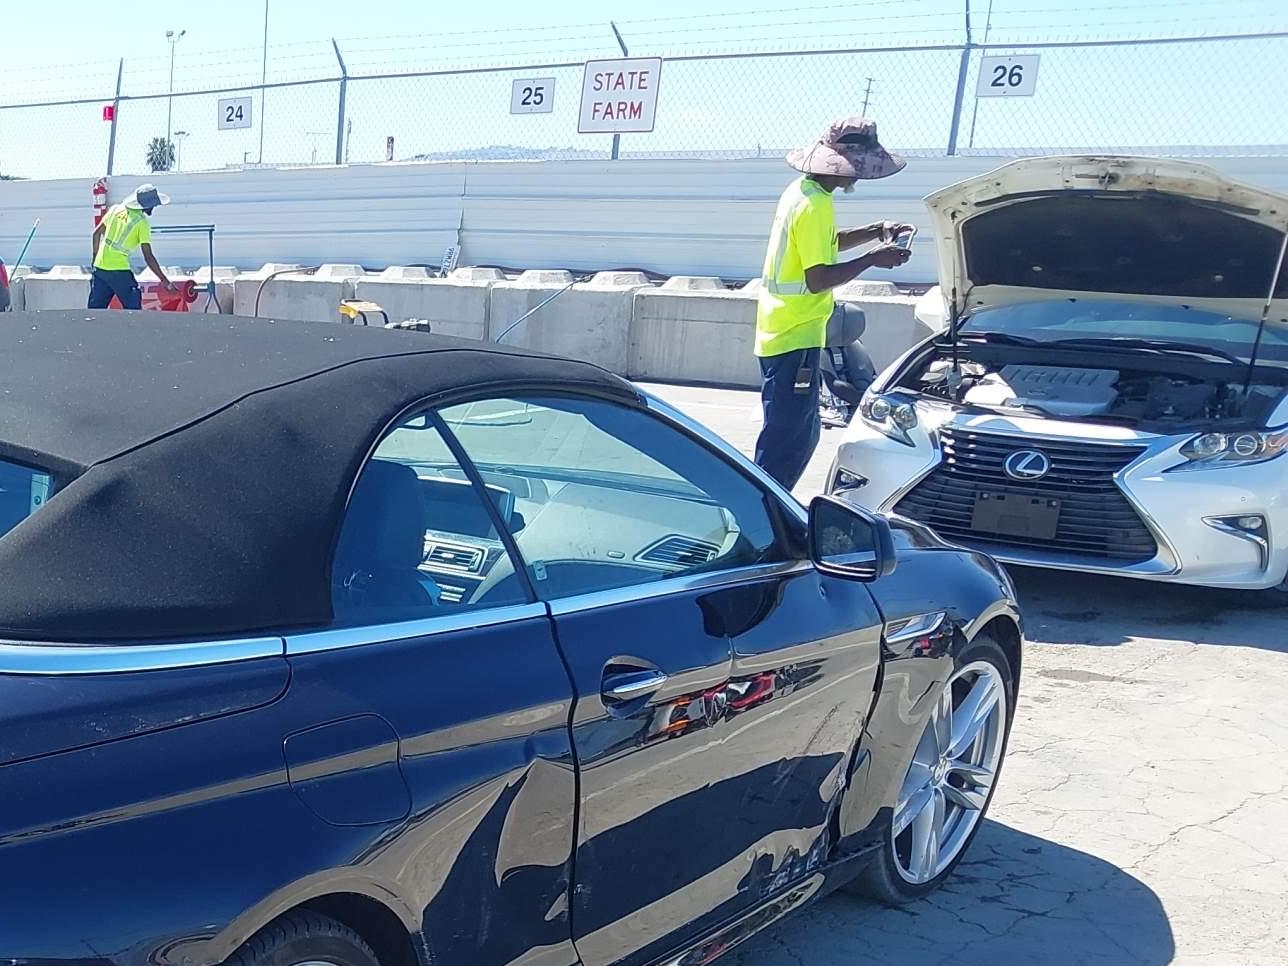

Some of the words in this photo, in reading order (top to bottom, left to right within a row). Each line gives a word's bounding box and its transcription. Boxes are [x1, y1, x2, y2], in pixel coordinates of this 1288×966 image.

[593, 71, 649, 91] STATE
[991, 64, 1024, 88] 26
[521, 83, 544, 105] 25
[226, 105, 244, 125] 24
[592, 100, 643, 121] FARM
